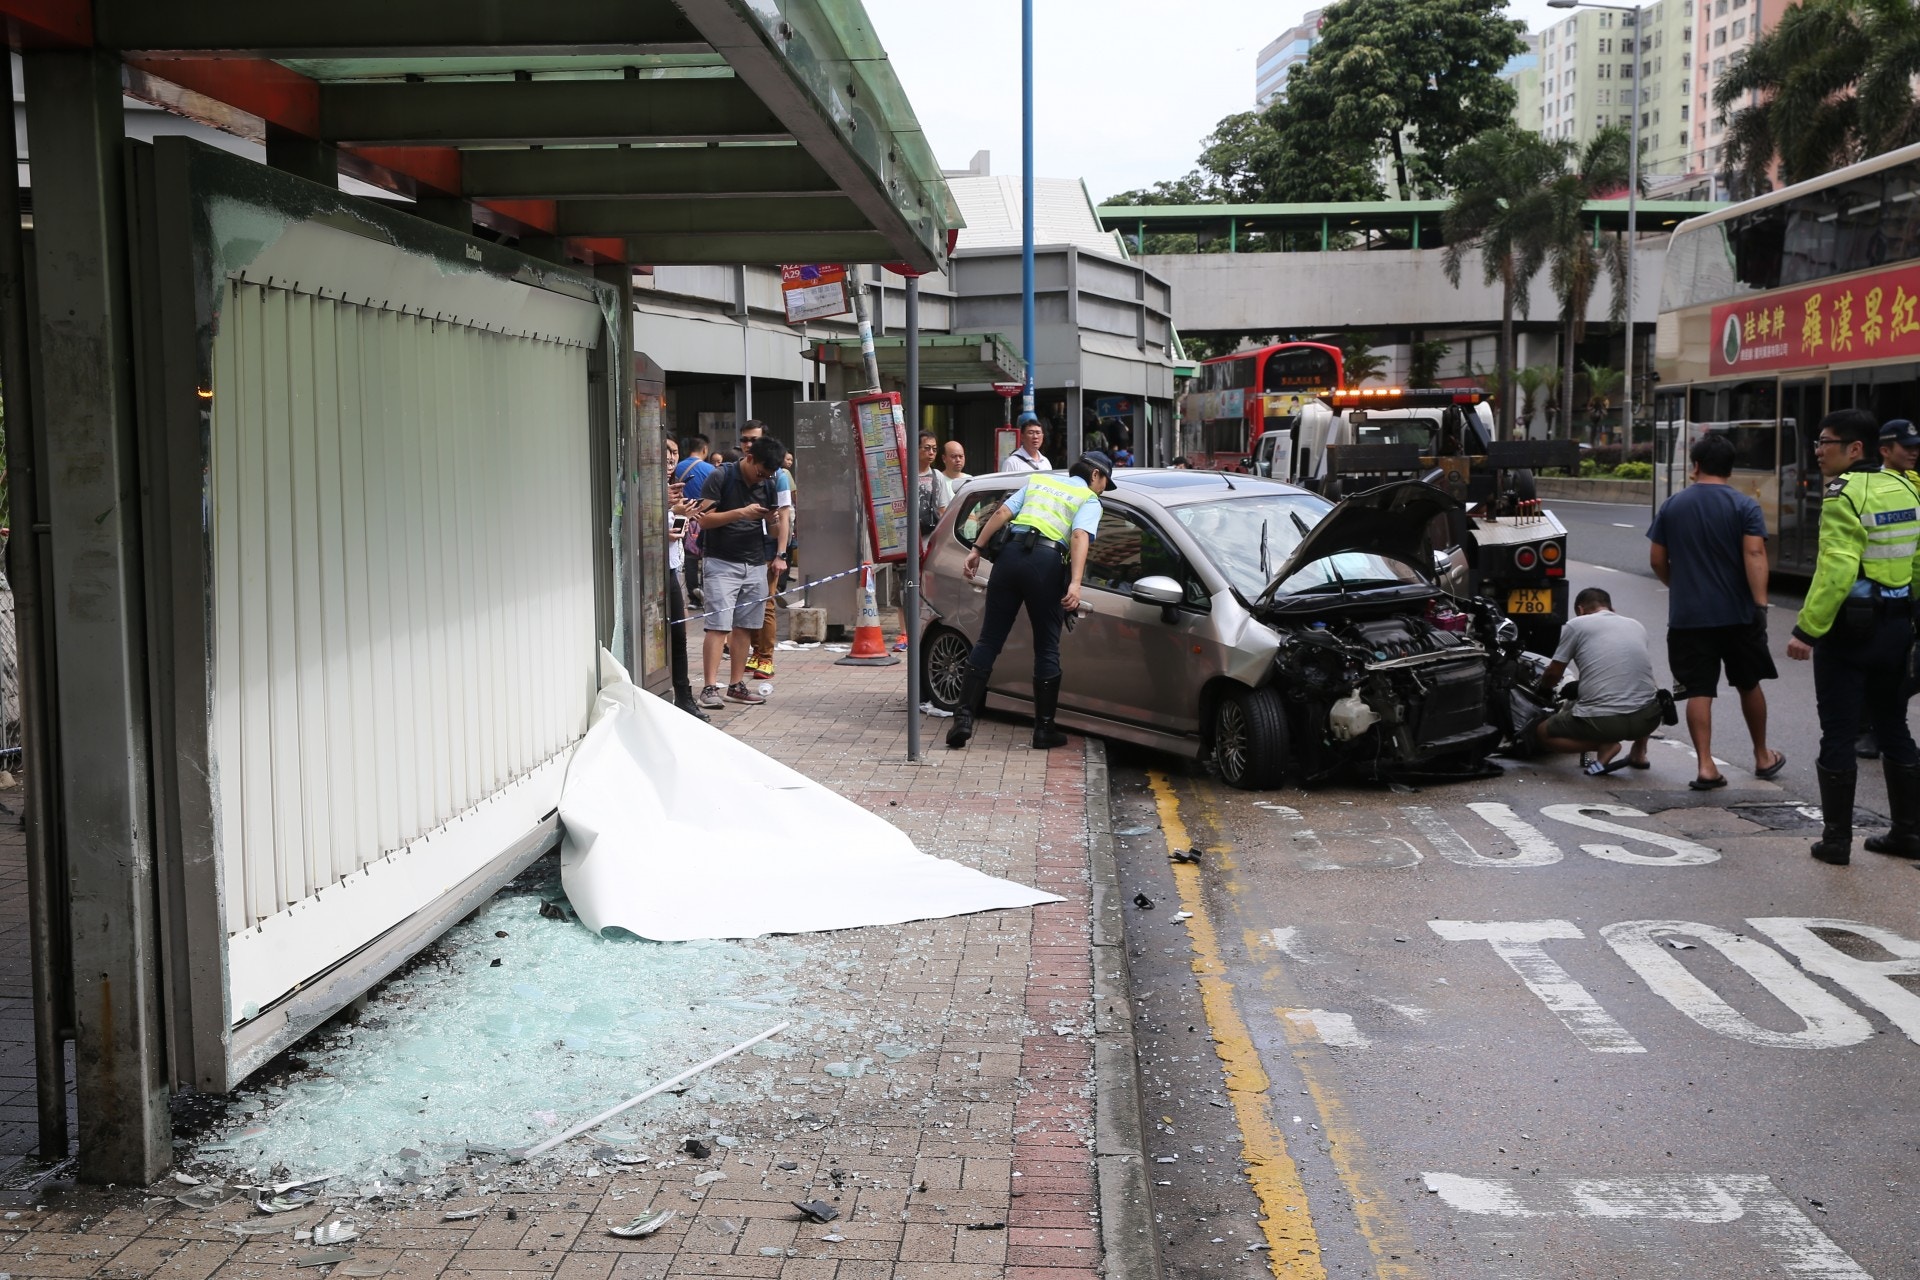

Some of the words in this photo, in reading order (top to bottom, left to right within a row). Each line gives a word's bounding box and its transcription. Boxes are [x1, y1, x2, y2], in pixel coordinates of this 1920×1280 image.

[784, 270, 800, 279] A29
[1801, 286, 1920, 358] 羅漢果紅
[1042, 486, 1065, 496] POLICE
[1887, 511, 1912, 522] POLICE
[1519, 590, 1539, 601] HX
[1515, 601, 1544, 612] 780
